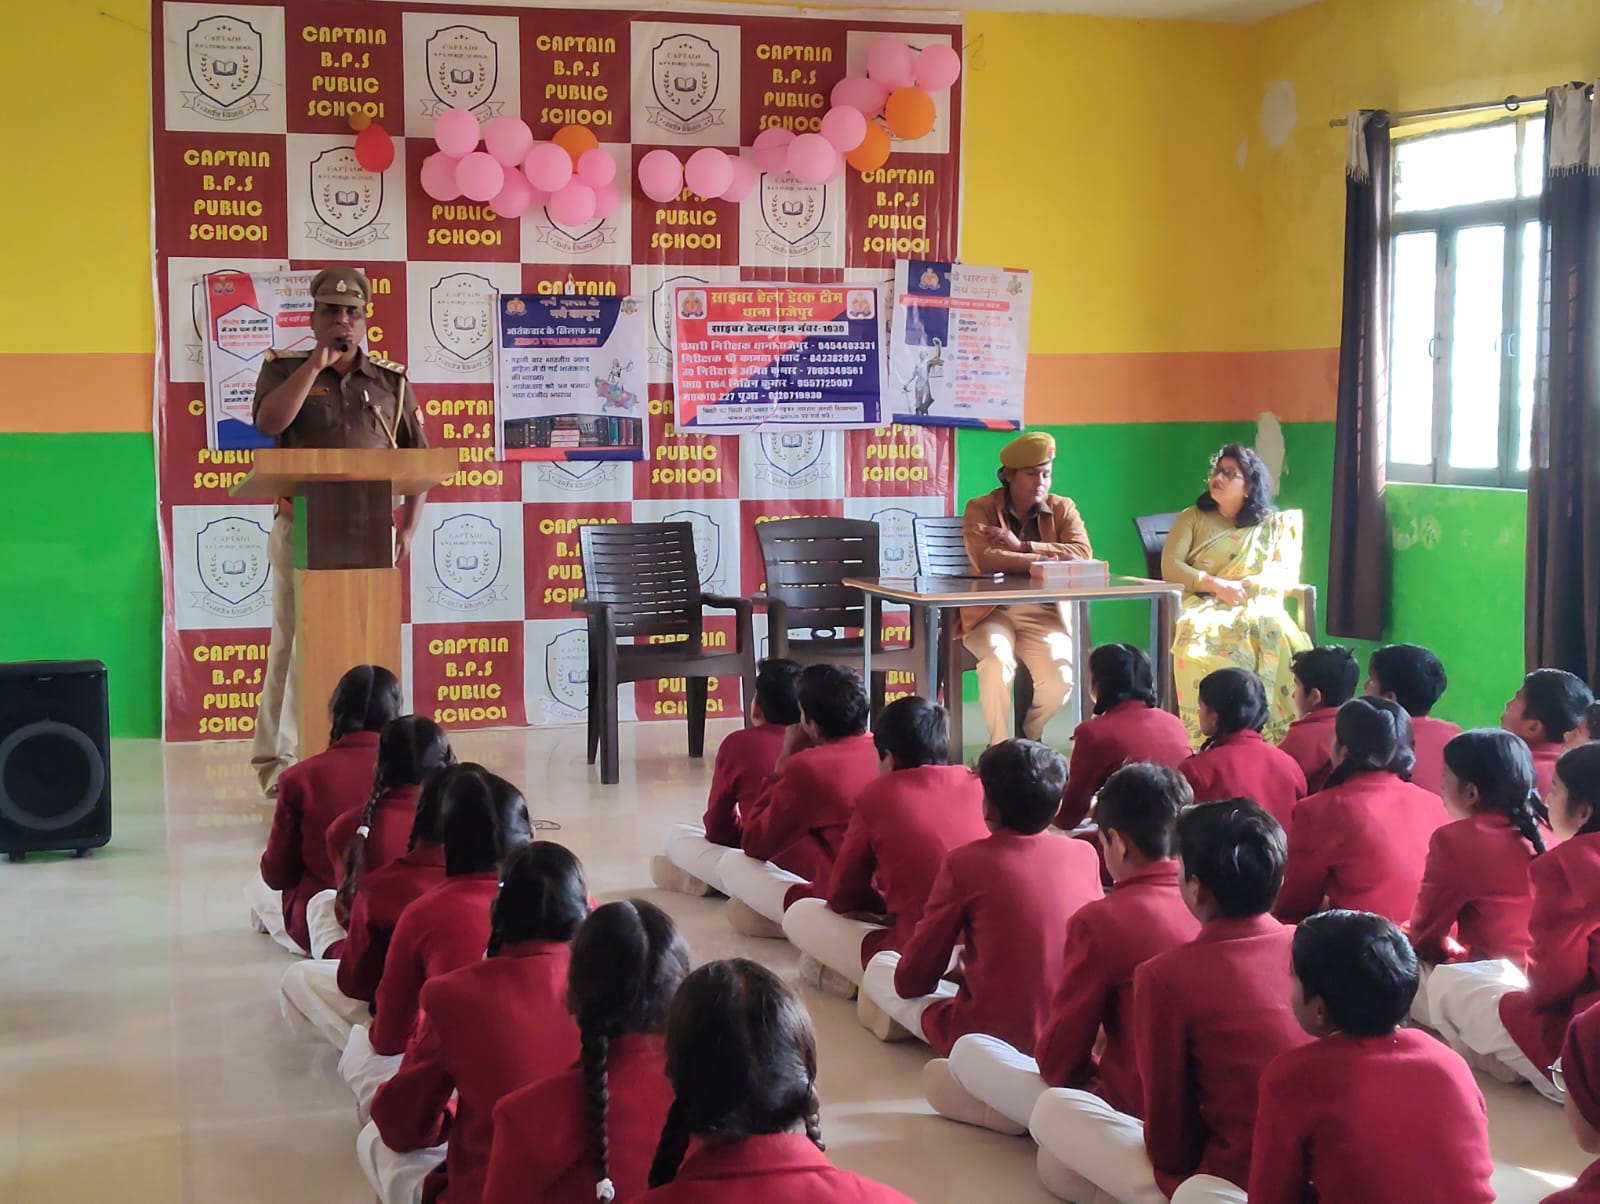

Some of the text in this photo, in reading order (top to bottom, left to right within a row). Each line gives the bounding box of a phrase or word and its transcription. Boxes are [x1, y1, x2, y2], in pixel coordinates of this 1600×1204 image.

[302, 26, 387, 45] CAPTAIN
[536, 35, 616, 54] CAPTAIN
[756, 44, 833, 62] CAPTAIN
[320, 51, 371, 69] B.P.S
[553, 60, 600, 77] B.P.S
[312, 75, 379, 94] PUBLIC
[772, 68, 817, 85] B.P.S
[545, 84, 608, 102] PUBLIC
[763, 91, 824, 109] PUBLIC
[759, 115, 822, 132] SCHOO
[183, 149, 270, 168] CAPTAIN
[203, 175, 253, 191] B.P.S
[860, 168, 935, 185] CAPTAIN
[876, 191, 920, 207] B.P.S
[194, 199, 263, 217] PUBLIC
[432, 204, 497, 221] PUBLIC
[655, 208, 718, 226] PUBLIC
[867, 214, 926, 231] PUBLIC
[537, 279, 617, 296] CATAIN
[425, 399, 494, 416] CAPTAI
[443, 423, 491, 439] B.P.S
[198, 448, 255, 464] PUBLI
[655, 444, 717, 461] PUBLIC
[866, 444, 924, 460] PUBLIC
[428, 637, 509, 655] CAPTAIN
[212, 668, 262, 685] B.P.S
[446, 660, 493, 677] B.P.S
[437, 683, 501, 701] PUBLIC
